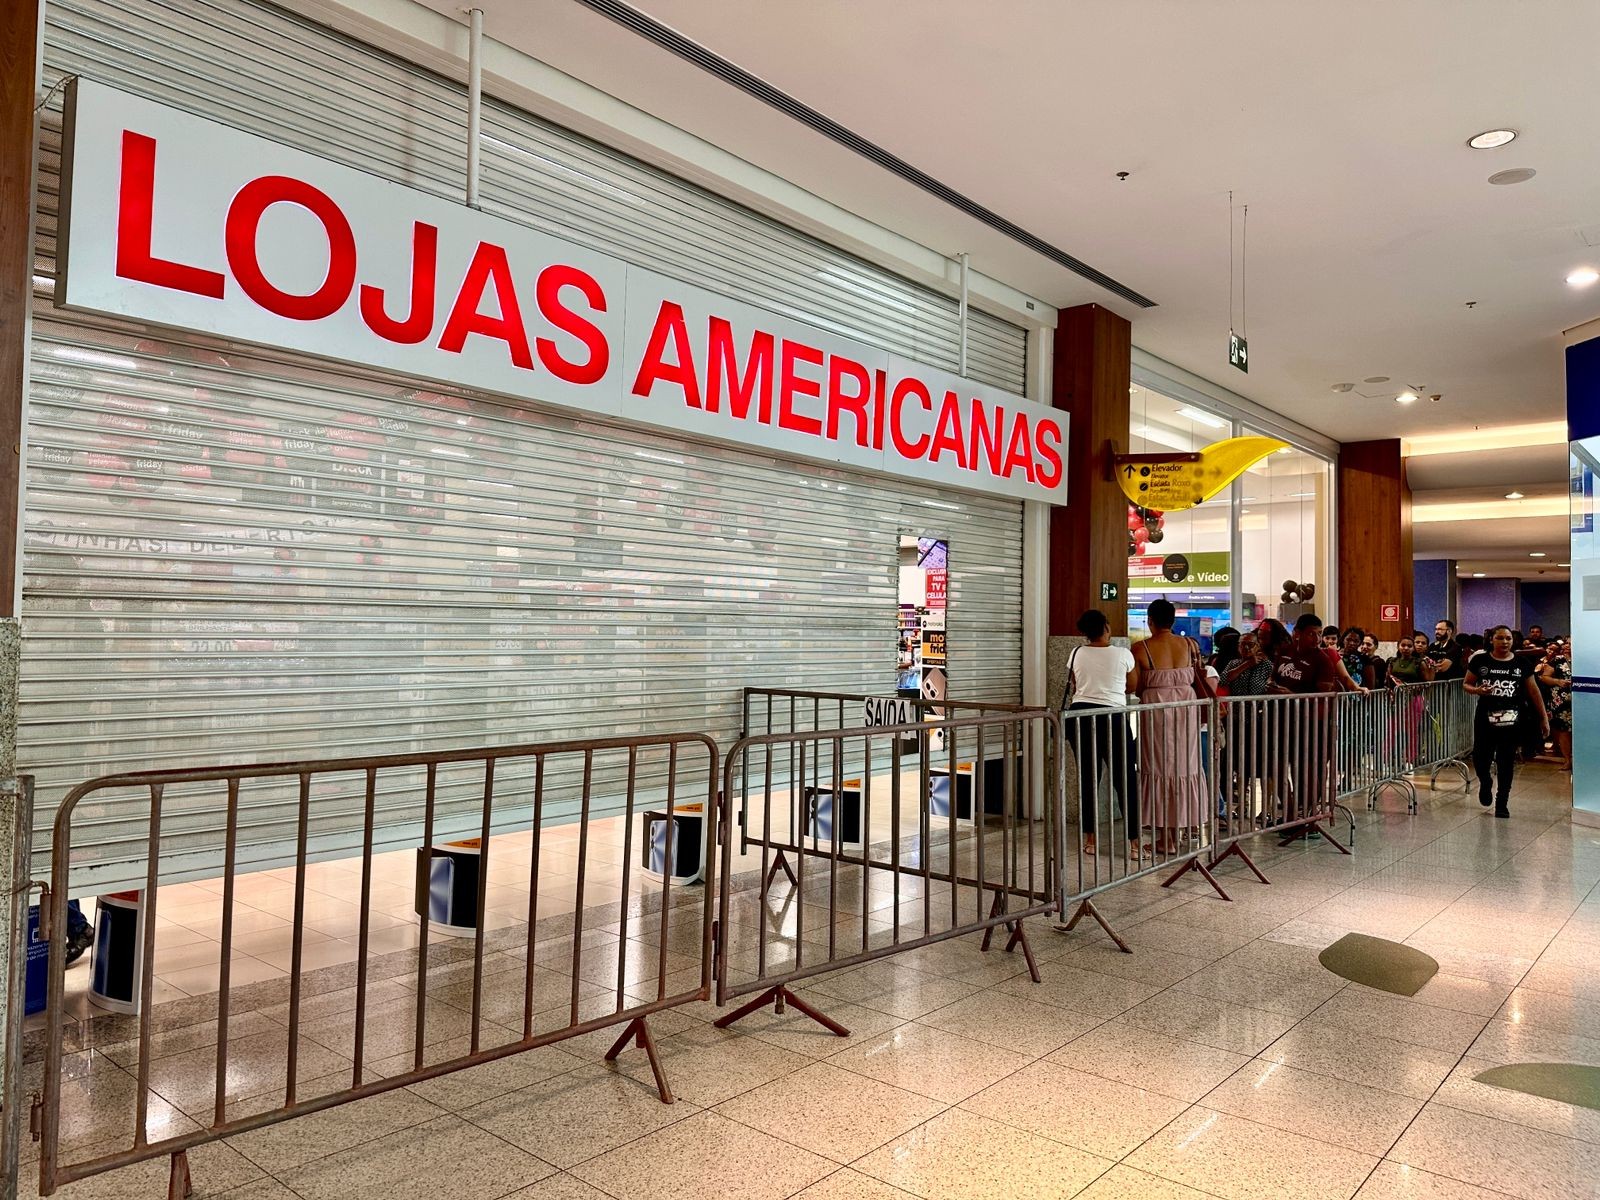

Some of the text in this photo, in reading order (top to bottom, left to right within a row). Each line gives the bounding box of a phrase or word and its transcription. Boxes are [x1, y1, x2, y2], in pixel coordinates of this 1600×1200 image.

[115, 129, 1064, 490] LOJAS AMERICANAS
[136, 460, 163, 471] friday
[1151, 464, 1183, 472] Elevador
[1197, 571, 1229, 582] Vídeo
[931, 583, 941, 591] TV
